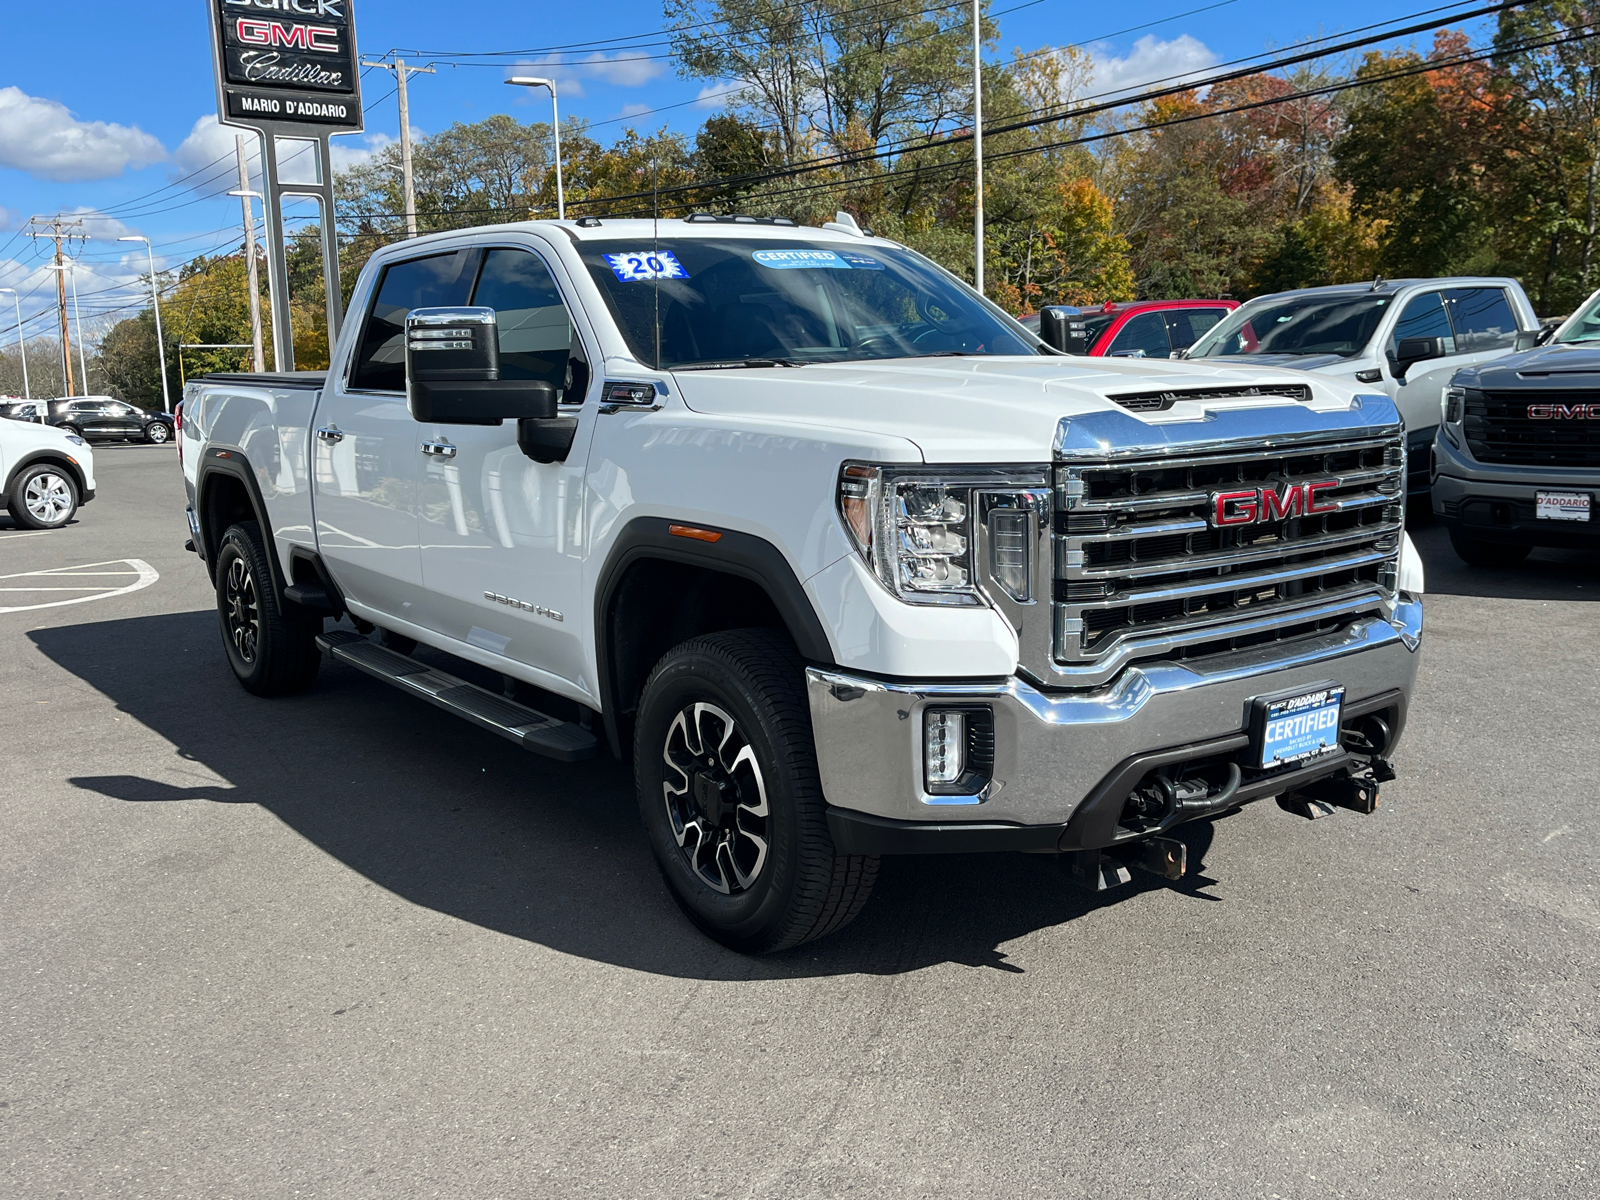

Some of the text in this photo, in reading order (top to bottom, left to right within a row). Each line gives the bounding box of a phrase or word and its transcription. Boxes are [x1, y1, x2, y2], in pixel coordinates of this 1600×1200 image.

[236, 17, 339, 53] GMC
[240, 51, 342, 86] Cadillac
[241, 97, 347, 118] MARIO D'ADDARIO
[756, 251, 836, 261] CERTIFIED
[628, 257, 664, 273] 20
[1527, 404, 1600, 420] GMC
[1211, 480, 1339, 528] GMC
[1536, 497, 1589, 507] D'ADDARIO
[536, 605, 564, 622] HD
[1287, 692, 1327, 709] D'ADDARIO
[1265, 708, 1338, 743] CERTIFIED
